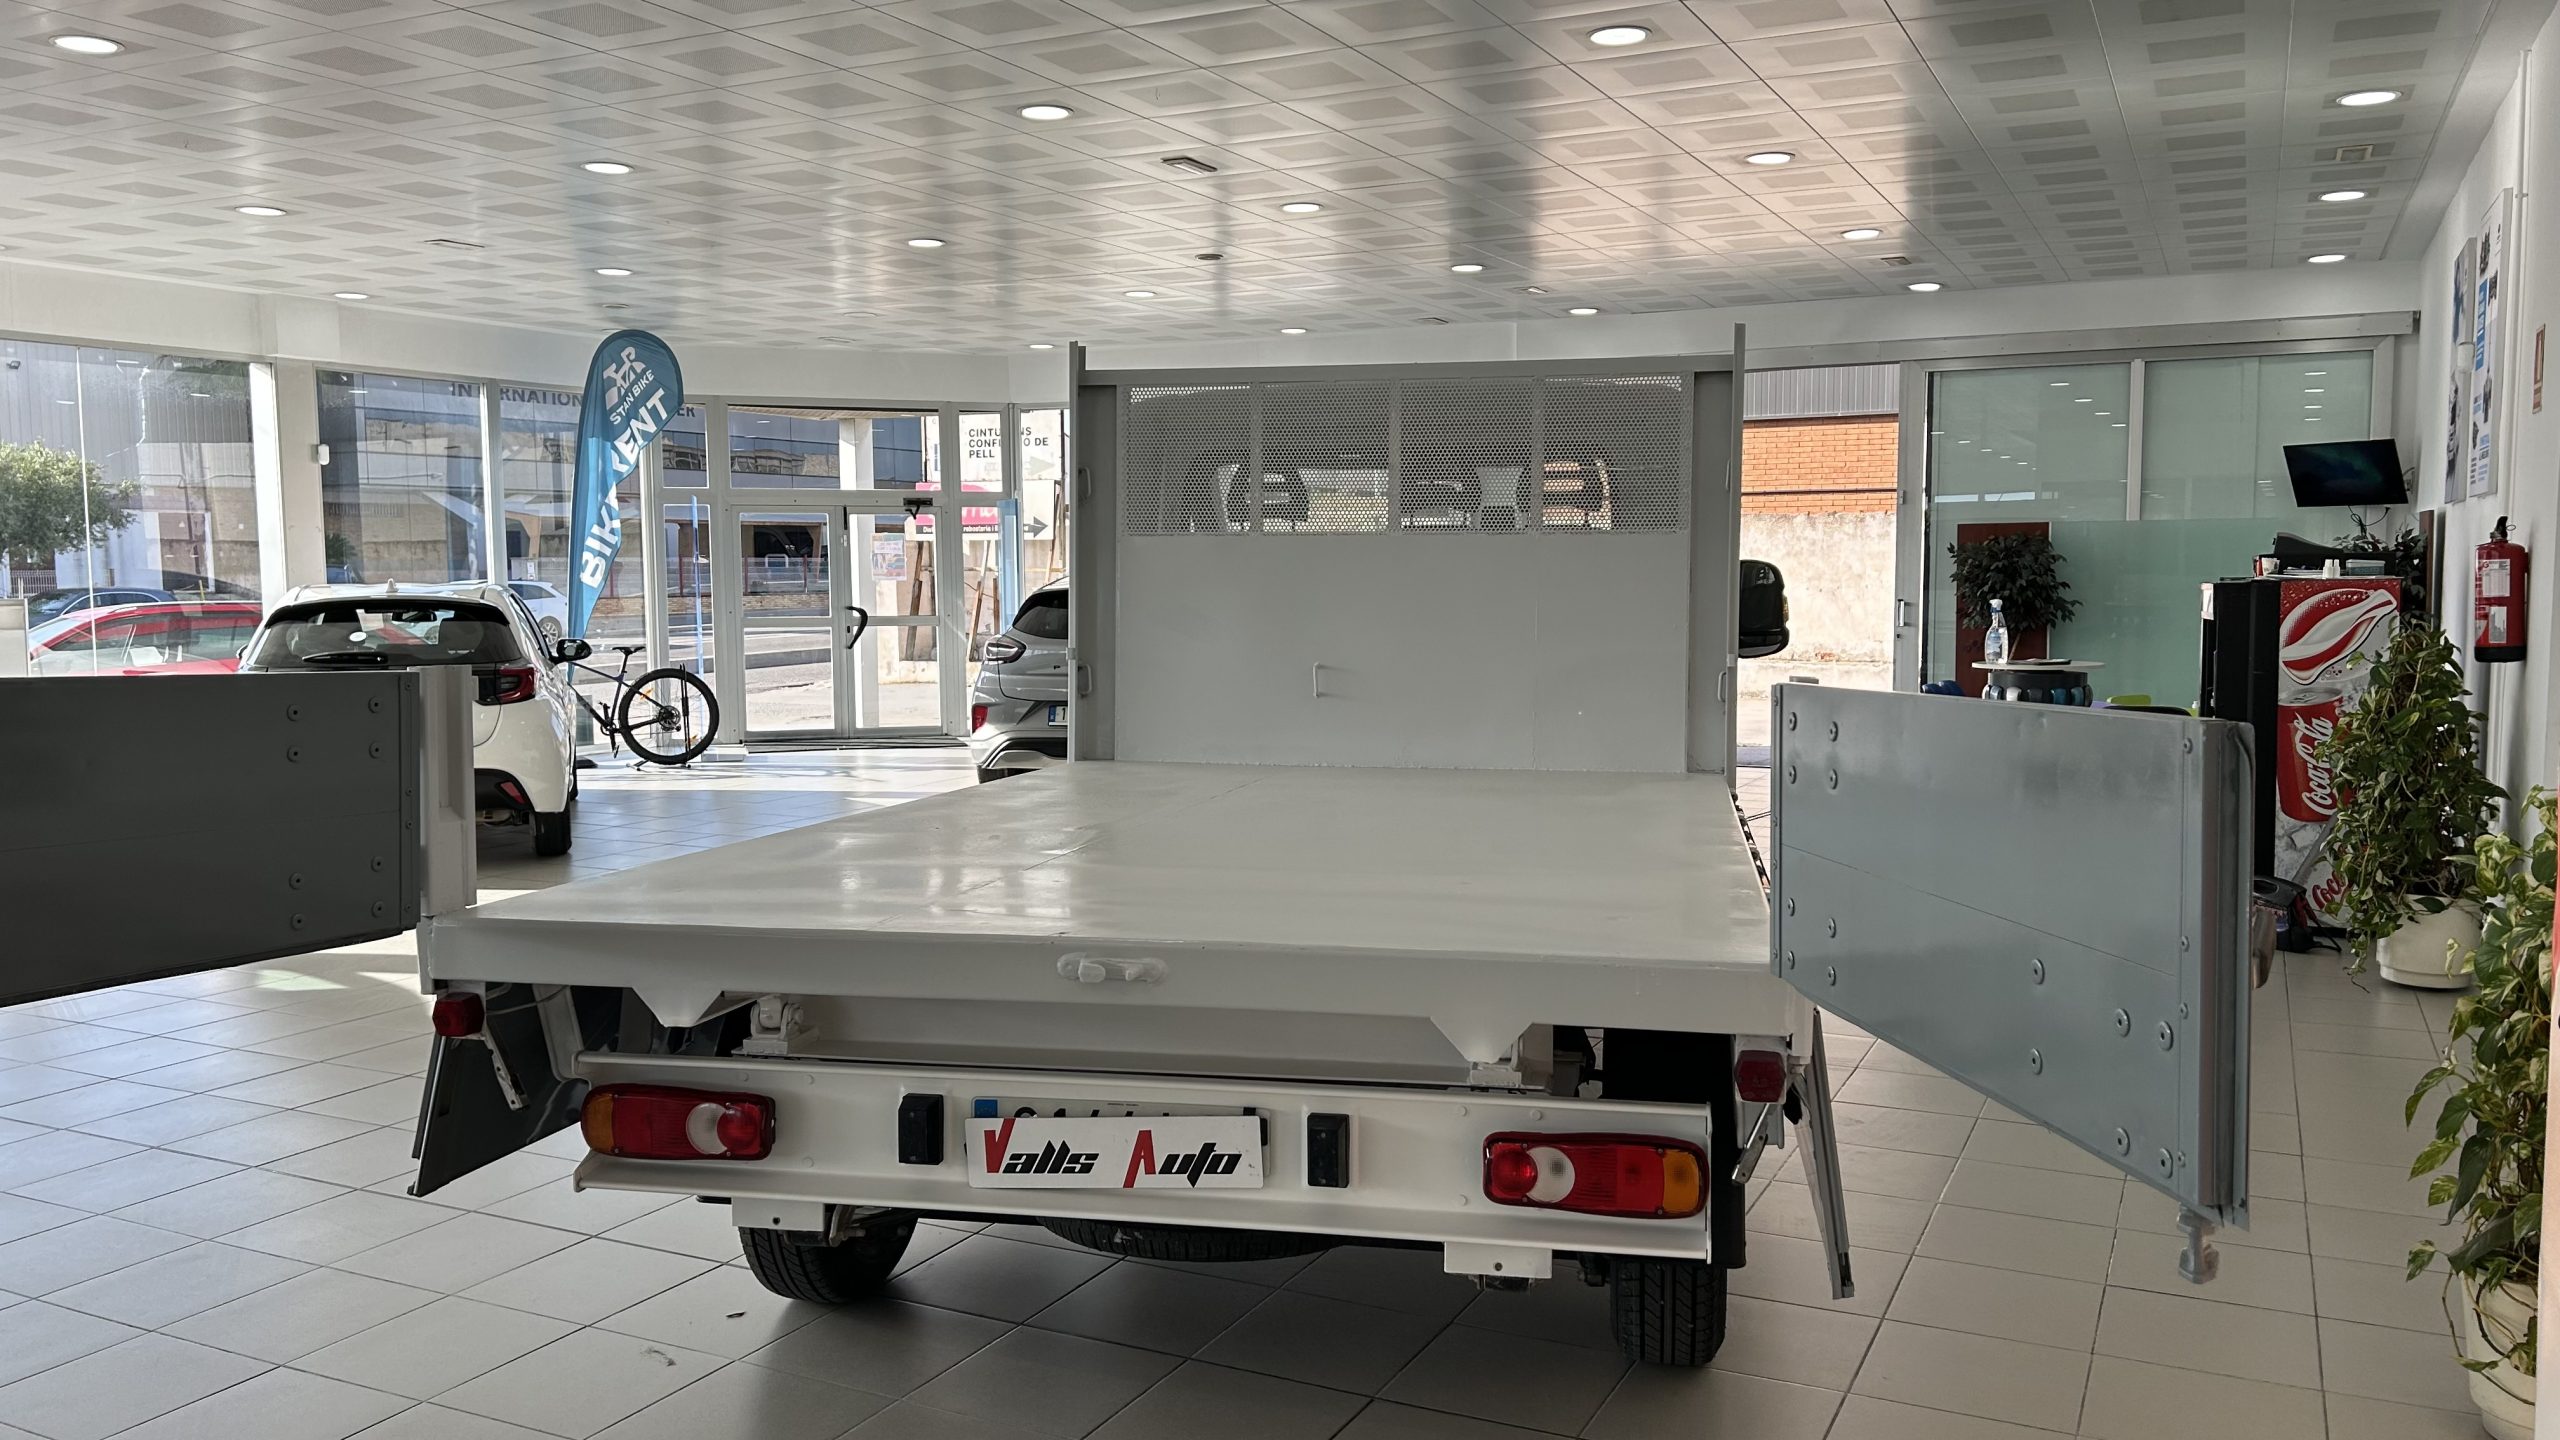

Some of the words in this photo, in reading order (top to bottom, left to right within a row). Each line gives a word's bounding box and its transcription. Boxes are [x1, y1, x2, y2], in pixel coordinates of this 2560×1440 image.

[609, 392, 634, 425] STAN
[631, 369, 655, 398] BIKE
[968, 449, 995, 459] PELL
[1034, 437, 1049, 447] DE
[983, 1117, 1100, 1174] Valls
[1123, 1129, 1243, 1189] Auto
